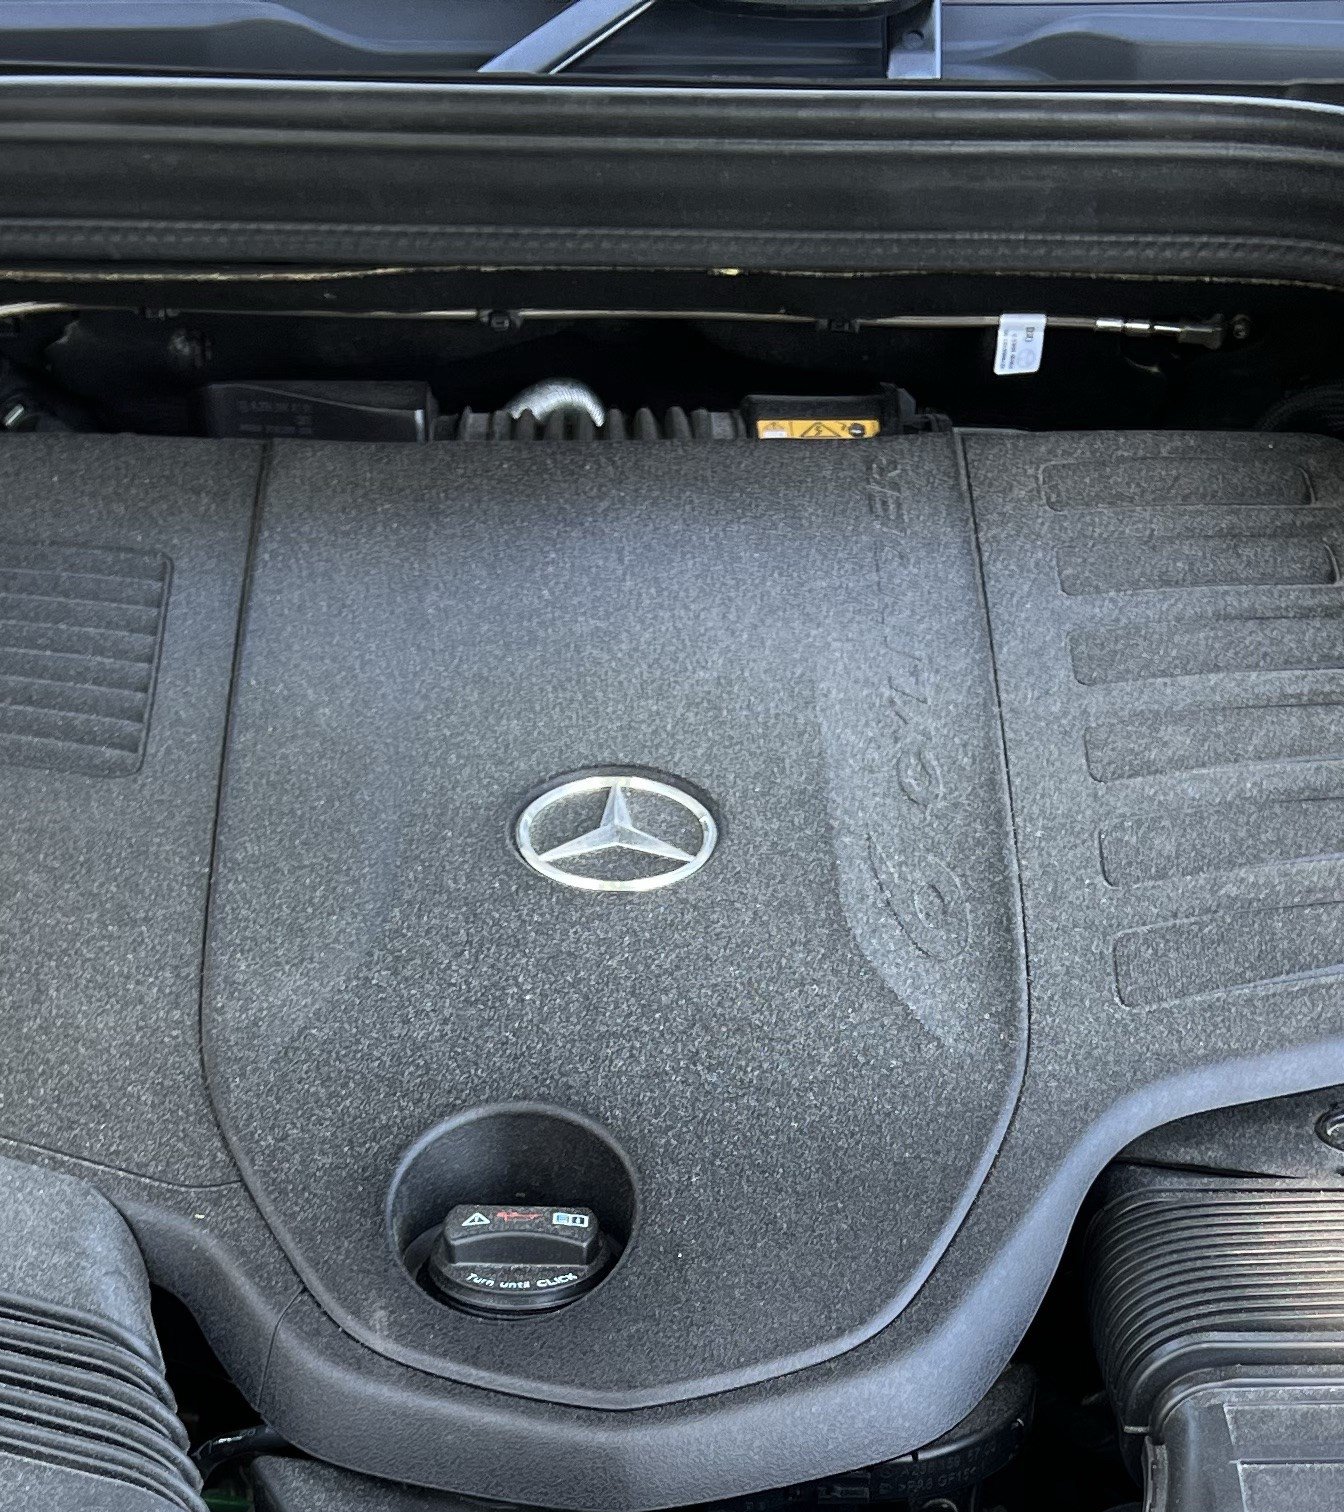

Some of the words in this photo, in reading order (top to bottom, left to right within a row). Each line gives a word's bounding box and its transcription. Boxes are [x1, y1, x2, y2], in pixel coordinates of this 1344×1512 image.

[864, 832, 971, 964] 6
[465, 1272, 495, 1287] Turn
[499, 1280, 531, 1289] until
[535, 1272, 578, 1287] CLICK
